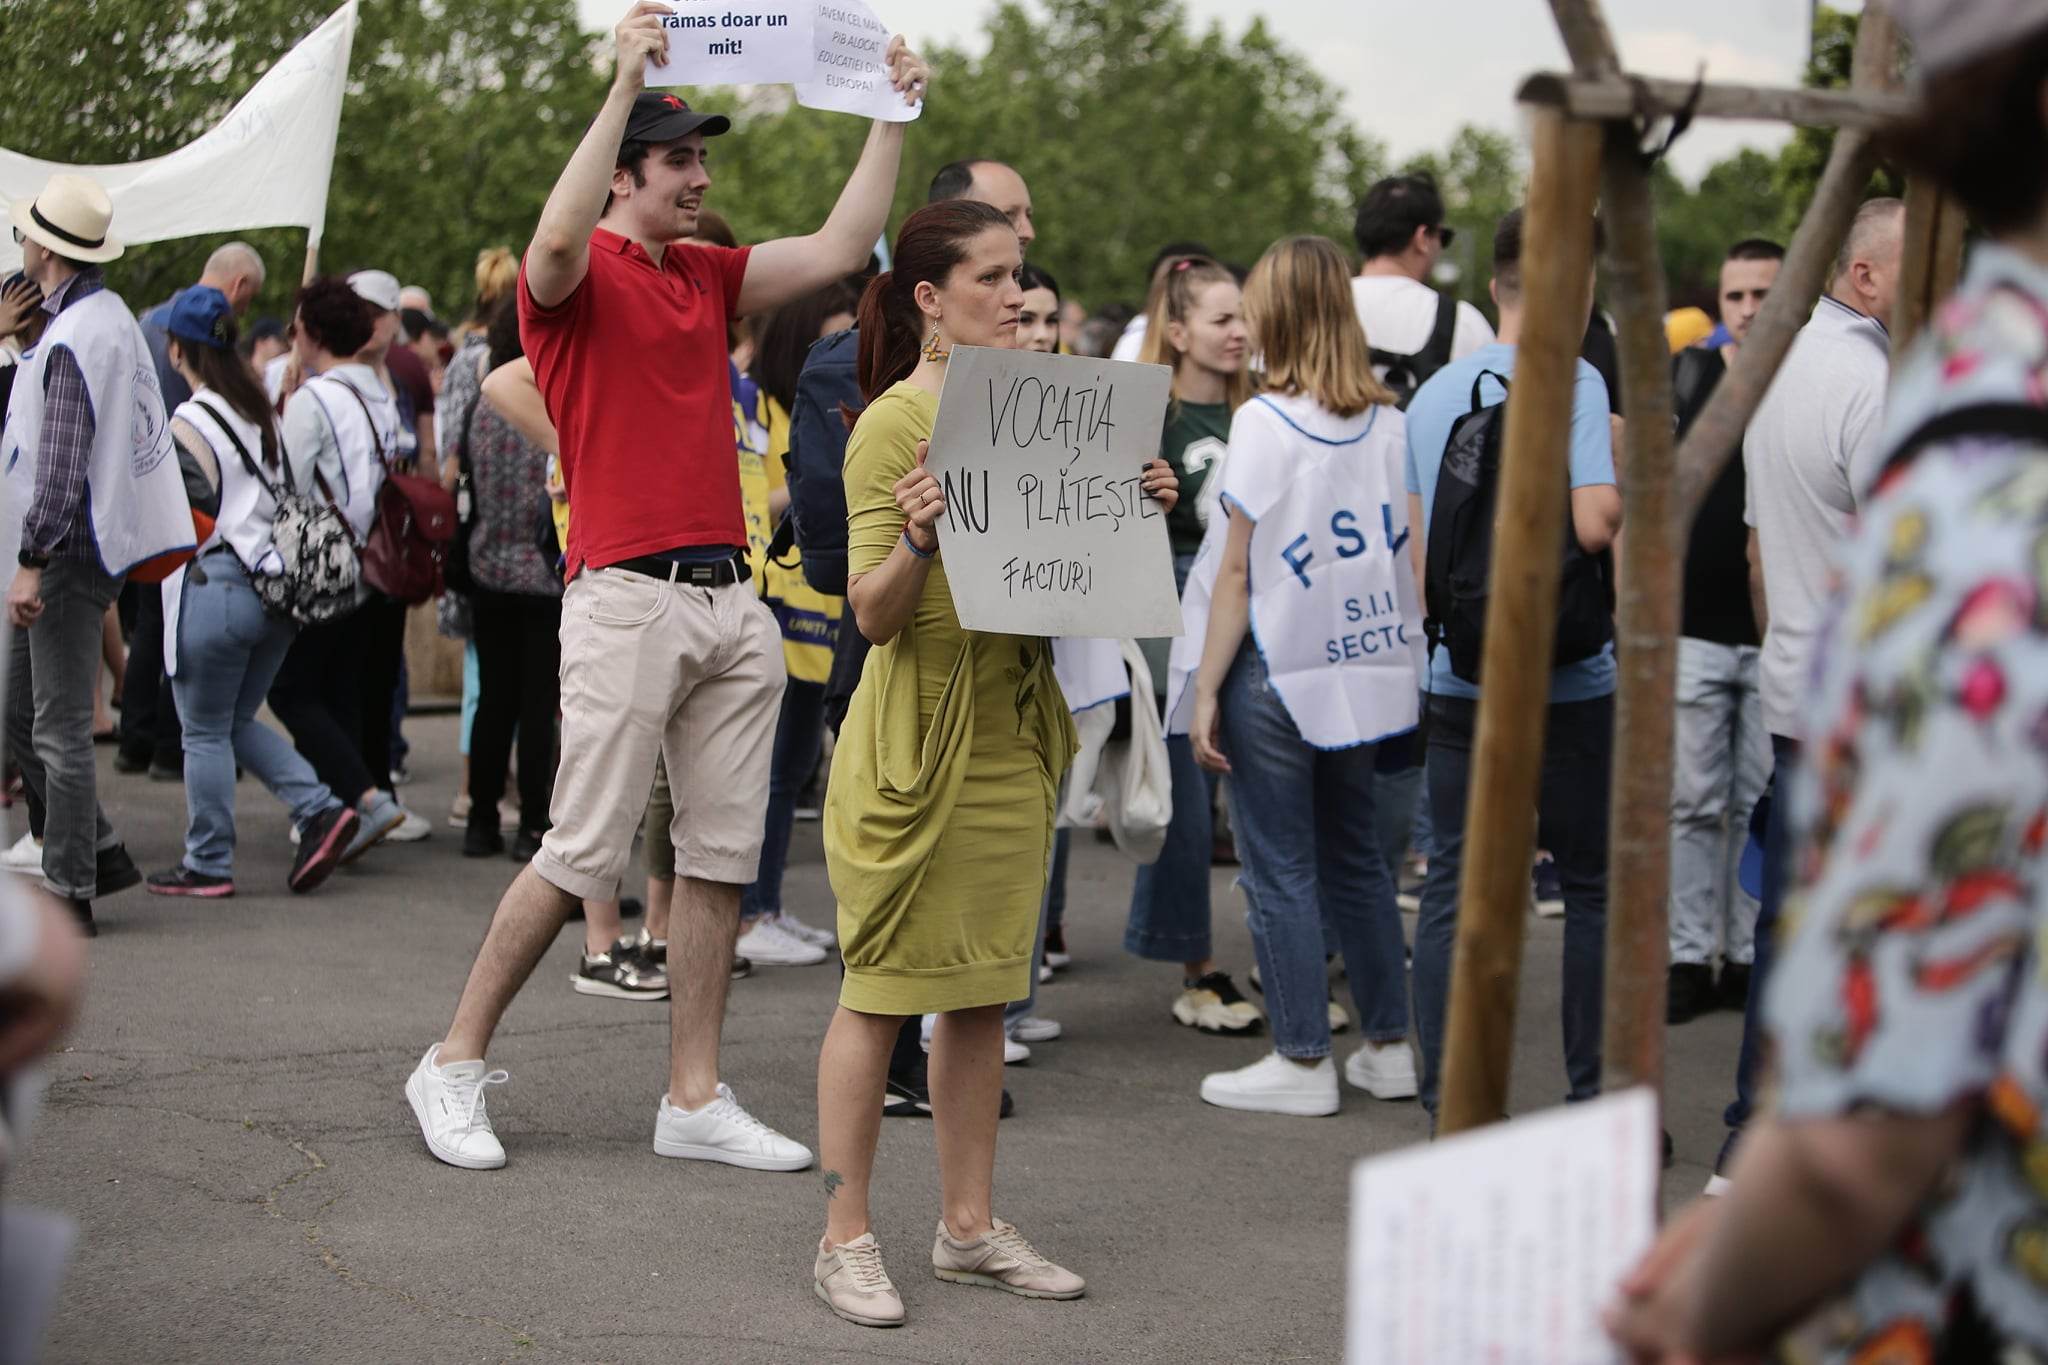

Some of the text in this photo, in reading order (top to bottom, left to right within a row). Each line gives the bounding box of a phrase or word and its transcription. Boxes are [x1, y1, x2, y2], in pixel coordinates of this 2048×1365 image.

[721, 11, 761, 27] doar
[766, 14, 788, 26] un
[708, 38, 742, 55] mit!
[846, 35, 880, 53] ALOCAT
[943, 466, 990, 534] NU
[1002, 552, 1093, 598] FACTURI
